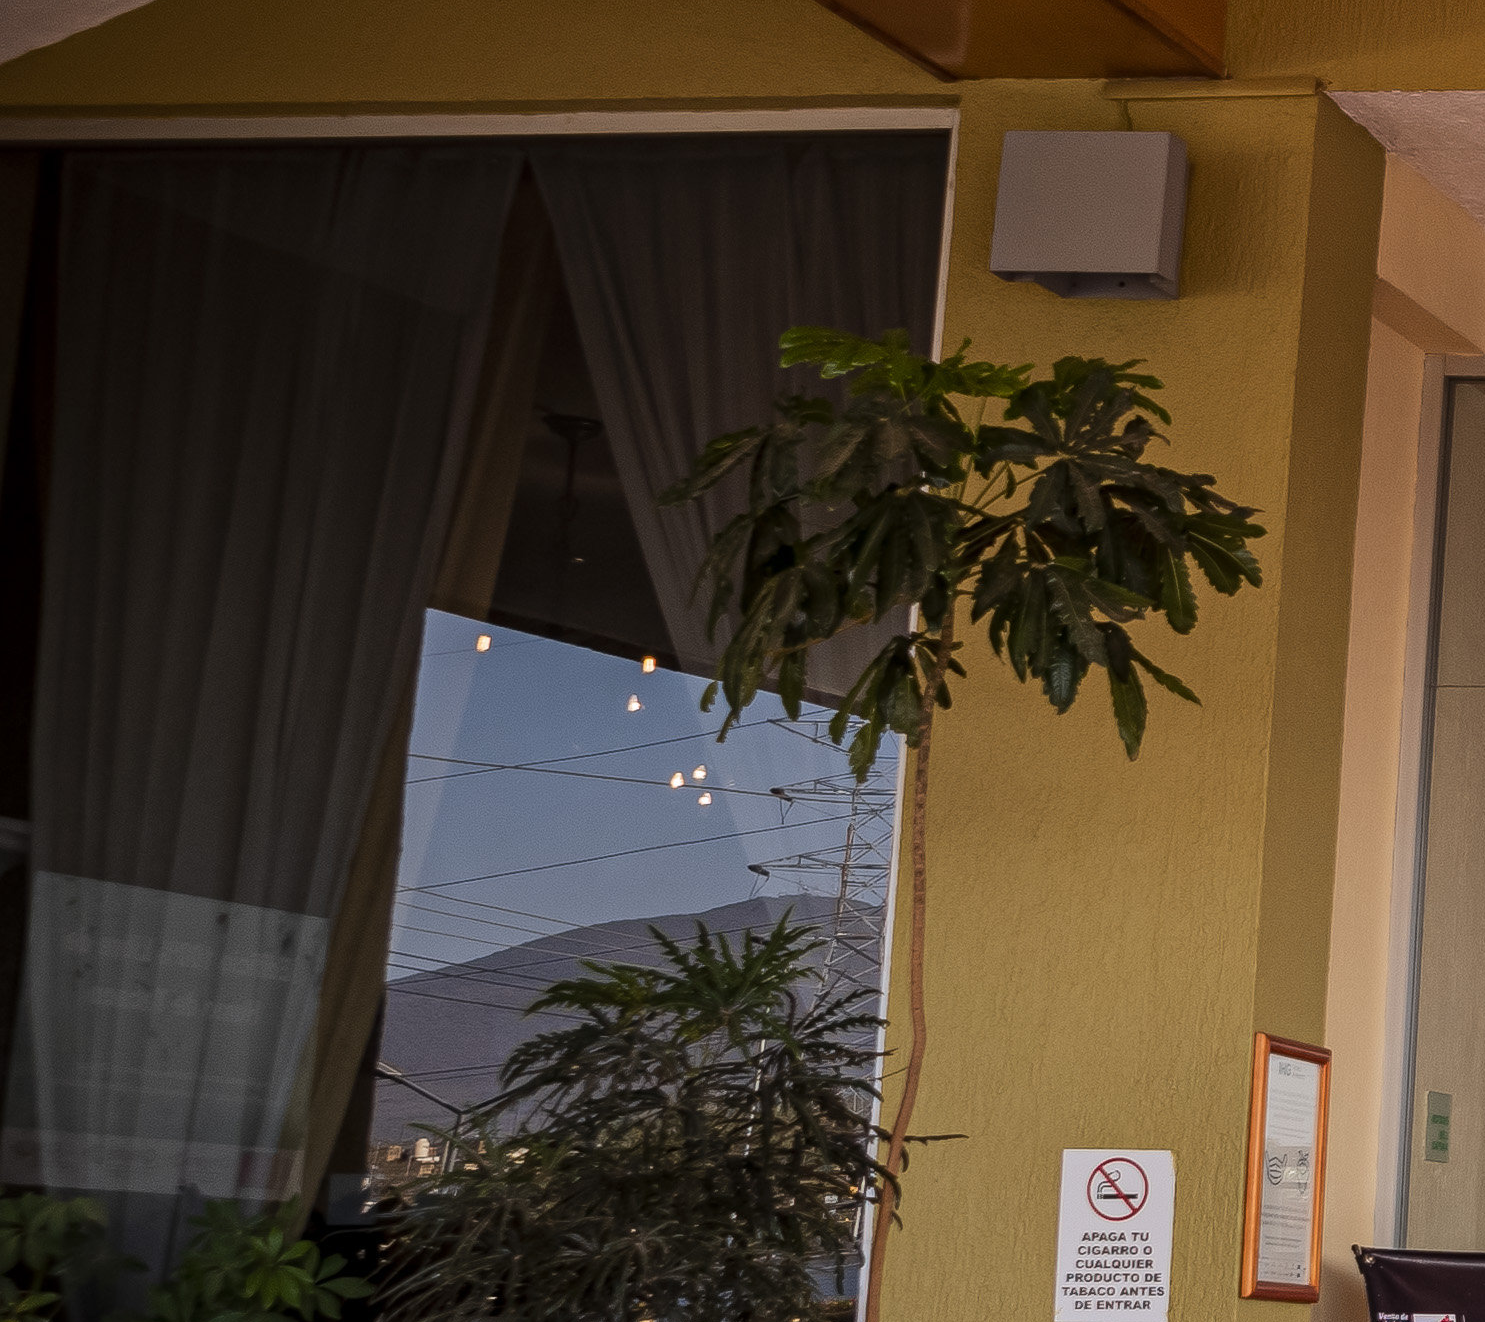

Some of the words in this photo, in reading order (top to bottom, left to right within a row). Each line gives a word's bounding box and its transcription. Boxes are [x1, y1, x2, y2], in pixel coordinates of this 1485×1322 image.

[1082, 1232, 1126, 1242] APAGA
[1132, 1232, 1149, 1241] TU
[1078, 1246, 1138, 1255] CIGARRO
[1144, 1246, 1153, 1255] O
[1075, 1259, 1153, 1269] CUALQUIER
[1066, 1273, 1140, 1283] PRODUCTO
[1145, 1273, 1162, 1282] DE
[1062, 1287, 1115, 1296] TABACO
[1120, 1287, 1164, 1296] ANTES
[1075, 1300, 1092, 1310] DE
[1097, 1300, 1151, 1310] ENTRAR
